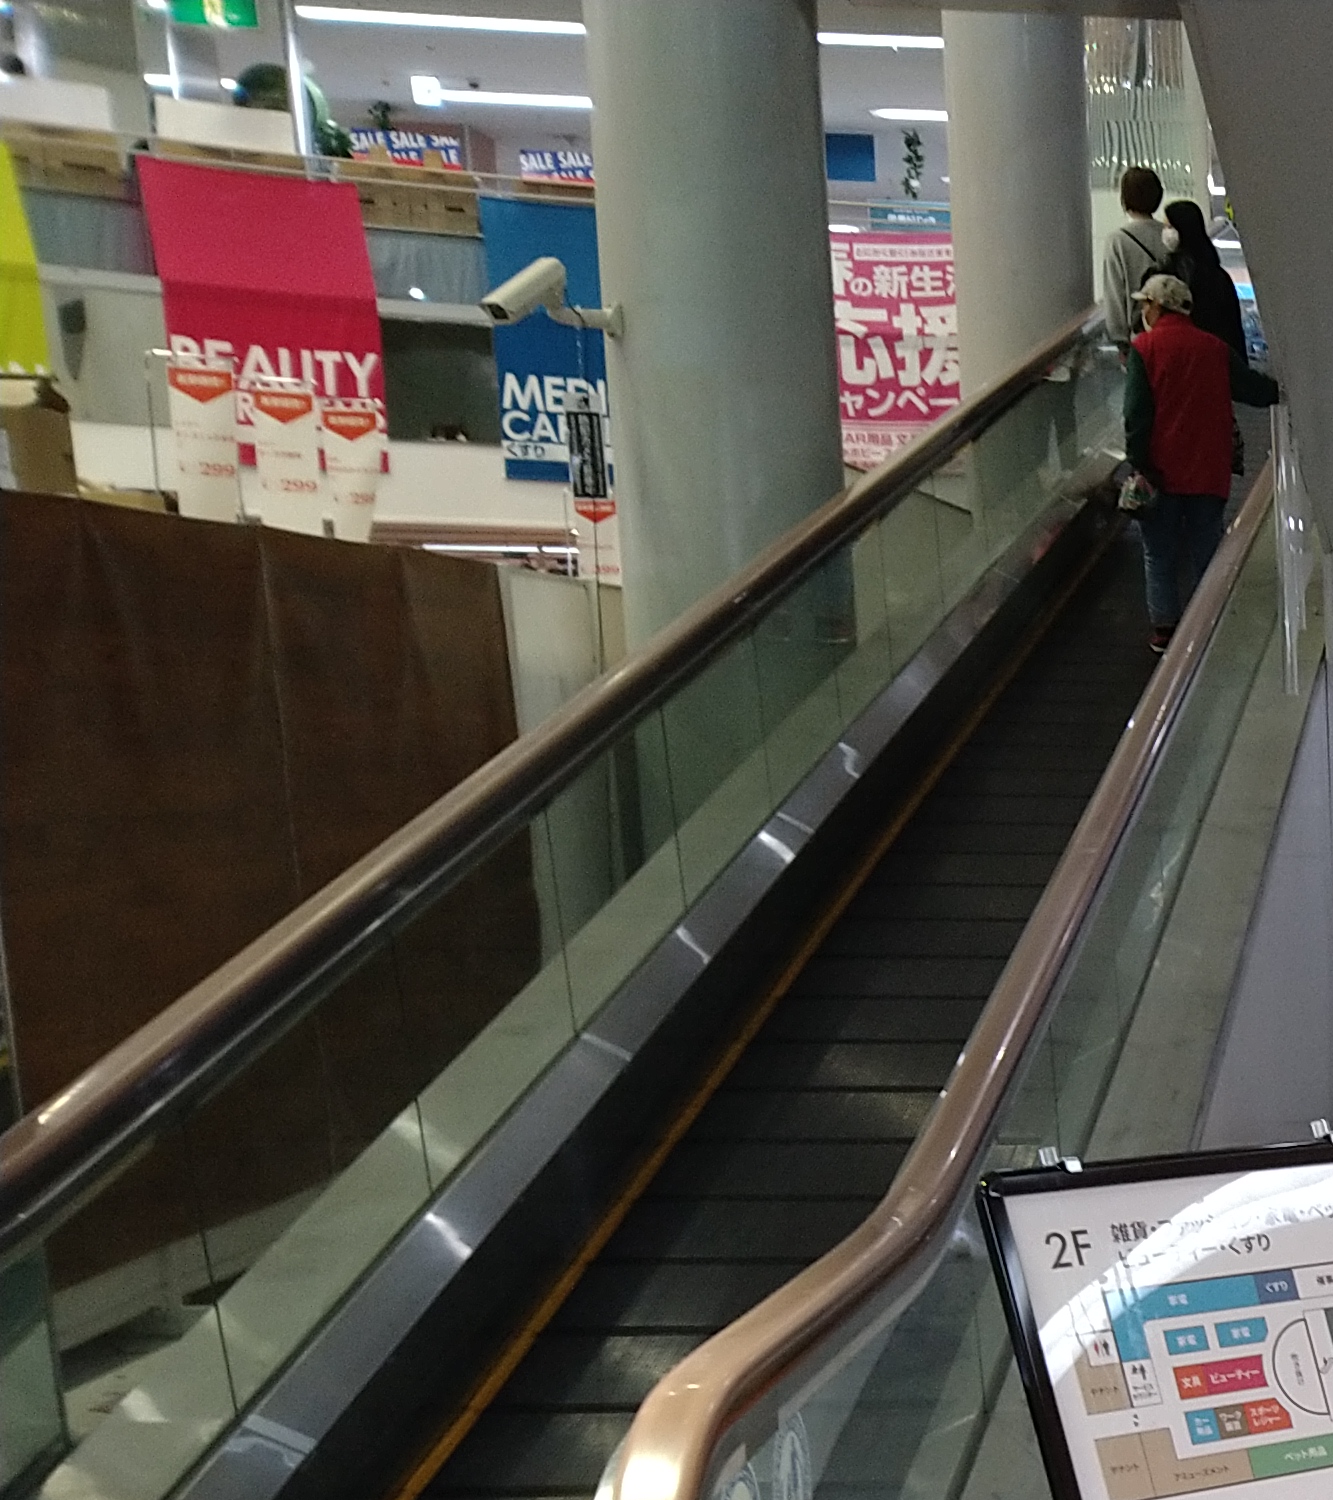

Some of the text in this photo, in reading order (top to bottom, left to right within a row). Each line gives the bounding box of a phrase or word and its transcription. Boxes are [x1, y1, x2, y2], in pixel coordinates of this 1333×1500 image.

[1045, 1229, 1093, 1270] 2F
[1209, 1368, 1262, 1384] ビューティー
